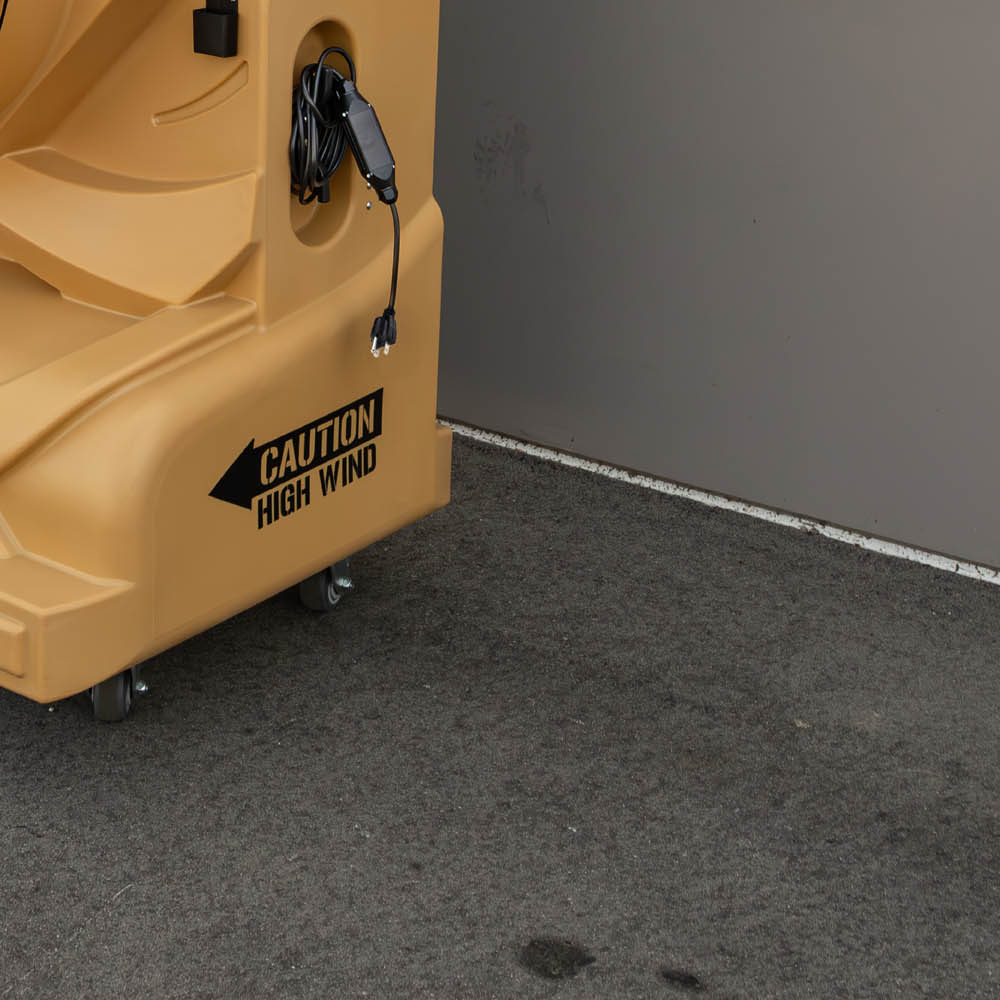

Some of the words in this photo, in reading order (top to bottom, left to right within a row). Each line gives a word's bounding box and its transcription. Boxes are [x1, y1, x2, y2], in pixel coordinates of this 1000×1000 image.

[257, 474, 311, 530] HIGH
[318, 442, 377, 497] WIND
[260, 398, 375, 486] CAUTION
